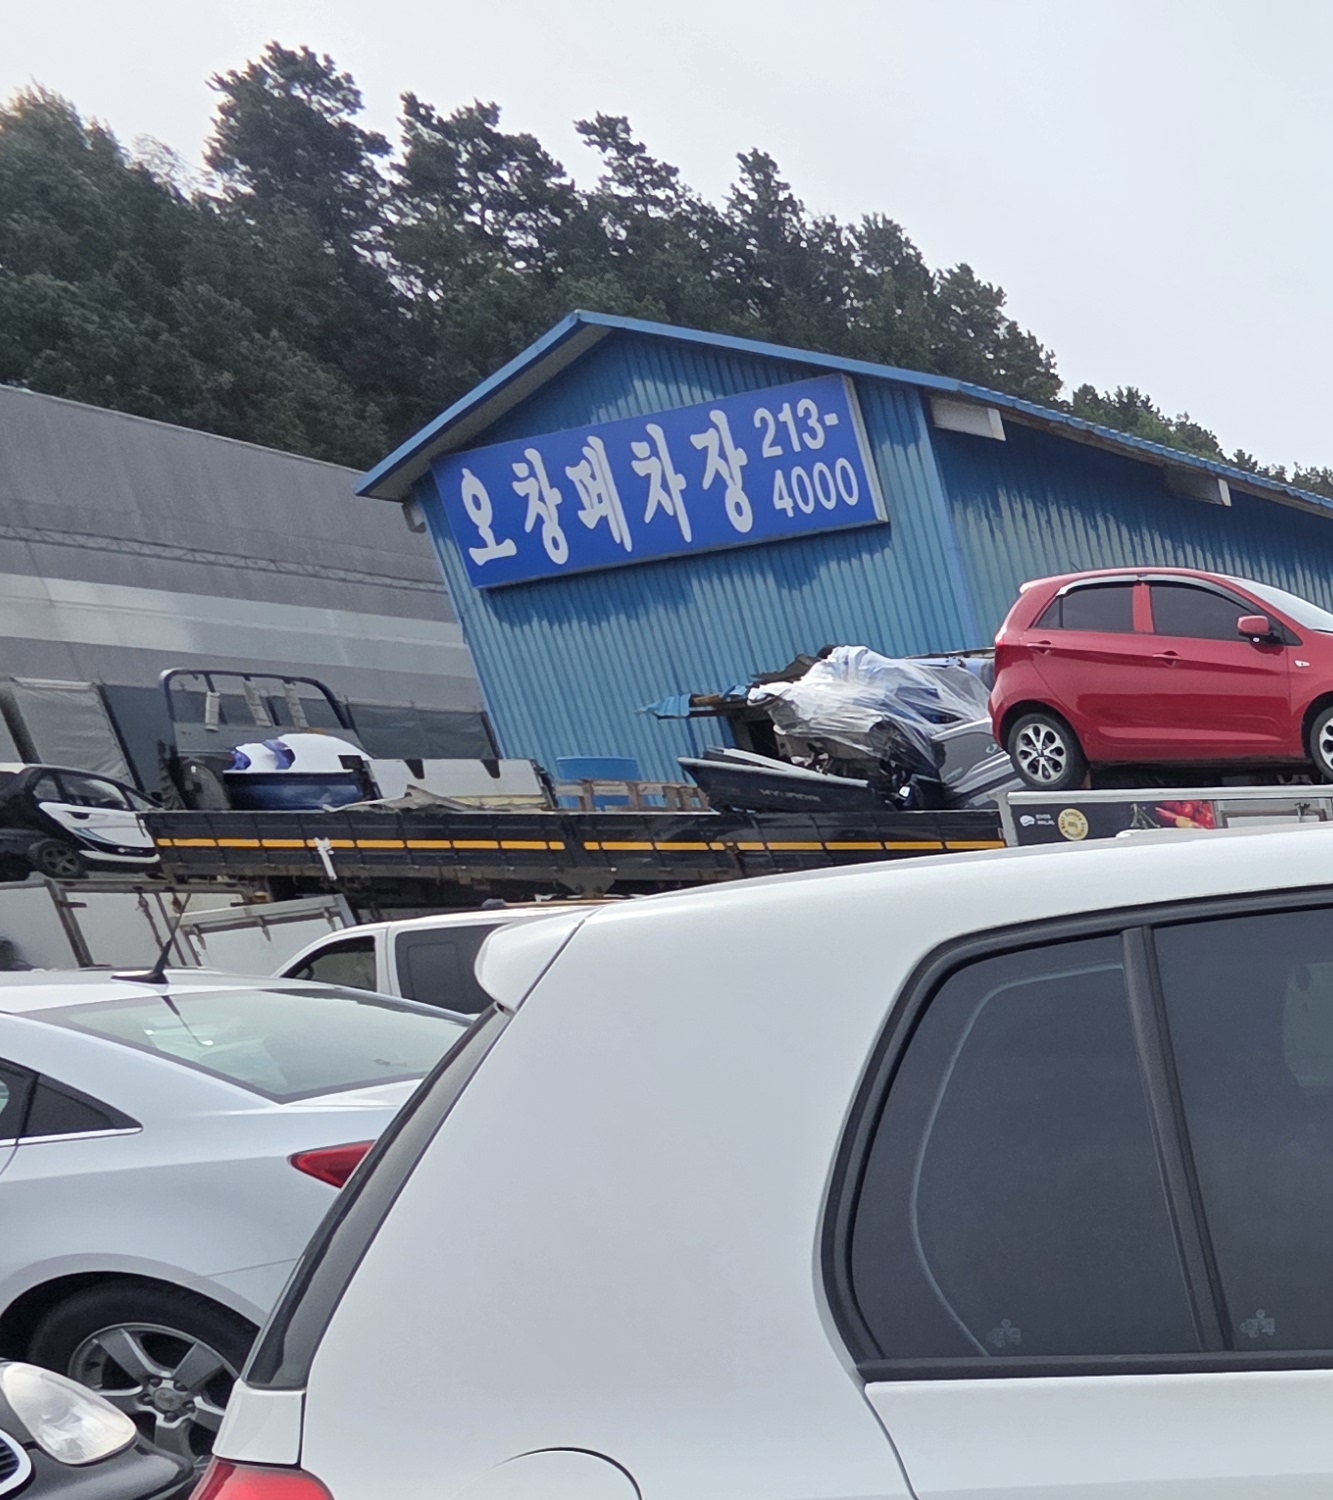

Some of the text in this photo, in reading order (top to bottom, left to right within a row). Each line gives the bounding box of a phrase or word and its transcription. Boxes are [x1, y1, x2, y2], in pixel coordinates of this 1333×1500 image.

[753, 398, 839, 459] 213-
[460, 409, 754, 566] 오창폐차장
[771, 457, 860, 519] 4000
